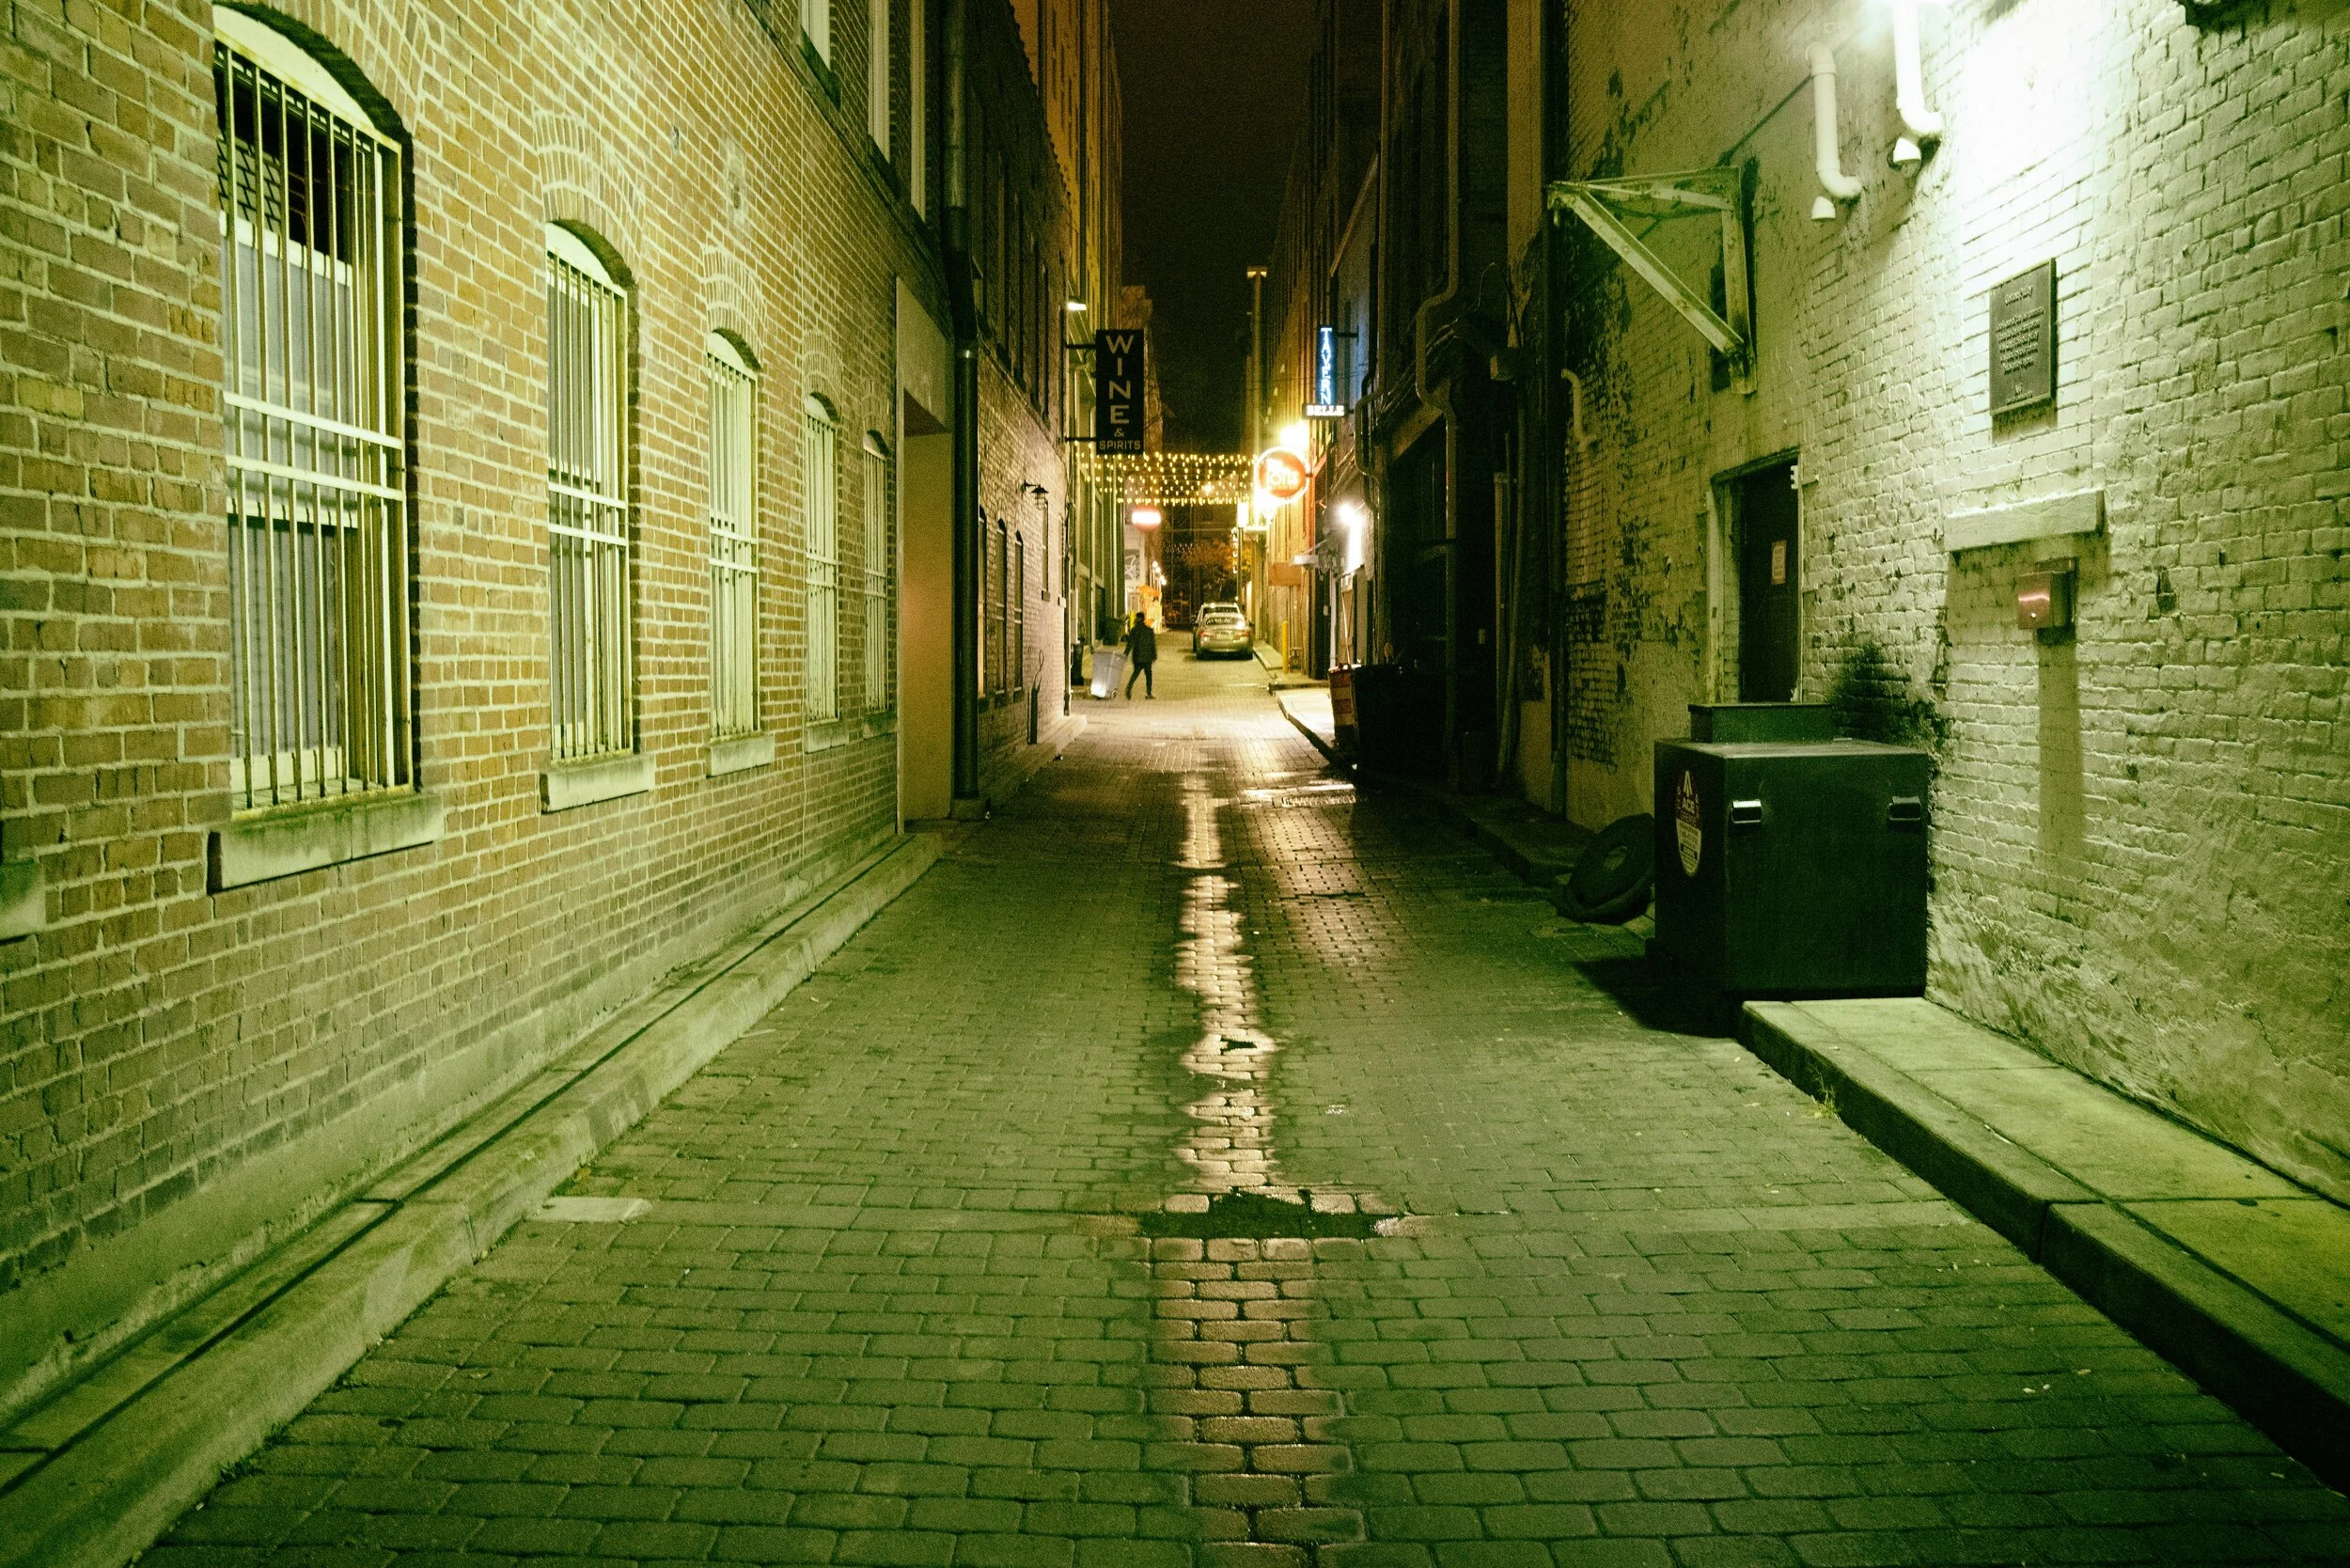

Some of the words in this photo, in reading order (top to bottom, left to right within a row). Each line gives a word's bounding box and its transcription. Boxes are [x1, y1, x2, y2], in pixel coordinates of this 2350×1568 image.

[1105, 334, 1134, 424] WINE
[1320, 327, 1332, 404] TAVERN
[1099, 440, 1141, 450] SPIRITS
[1114, 428, 1125, 437] &
